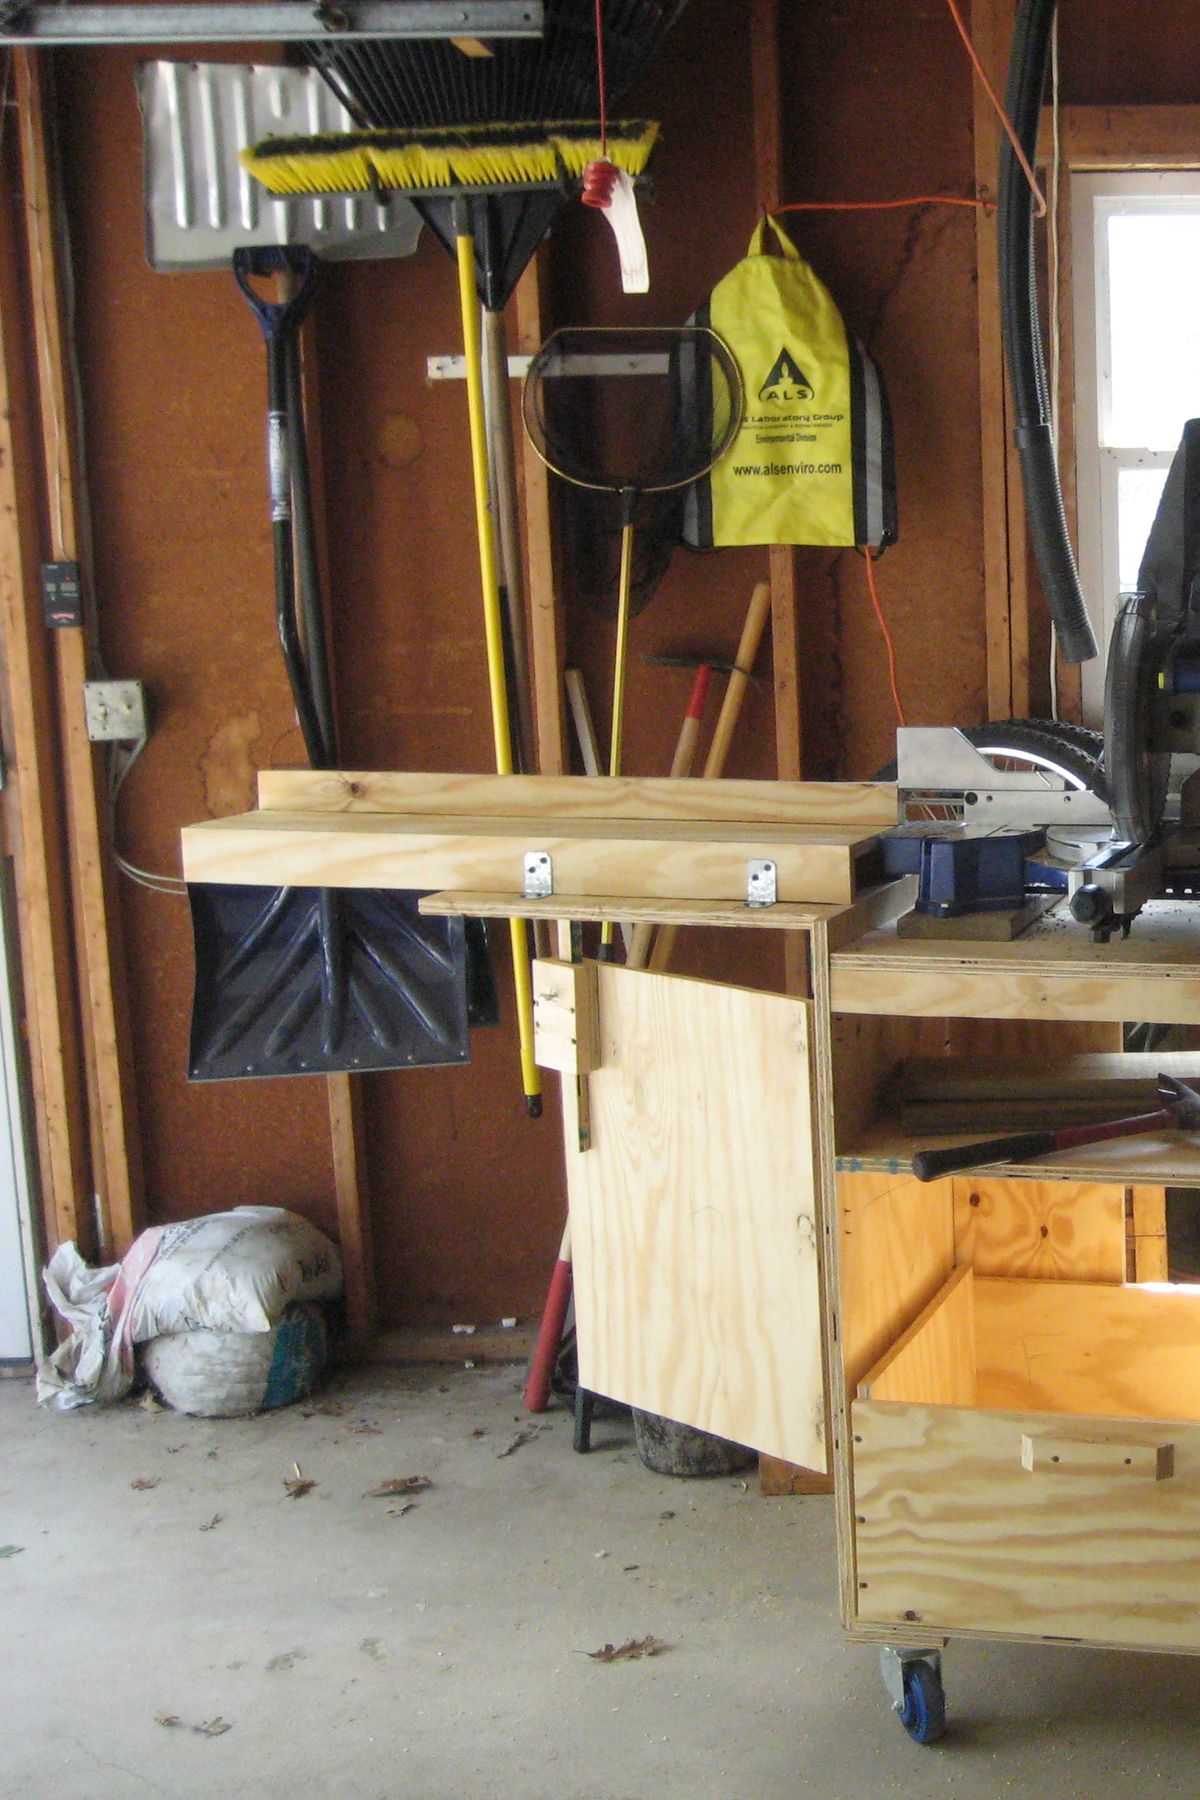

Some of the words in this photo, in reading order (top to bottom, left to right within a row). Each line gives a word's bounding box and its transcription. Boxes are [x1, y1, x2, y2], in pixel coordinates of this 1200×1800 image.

[767, 389, 808, 400] ALS
[751, 415, 810, 423] Laboratory
[812, 414, 844, 422] Group
[733, 462, 842, 476] www.alsenviro.com
